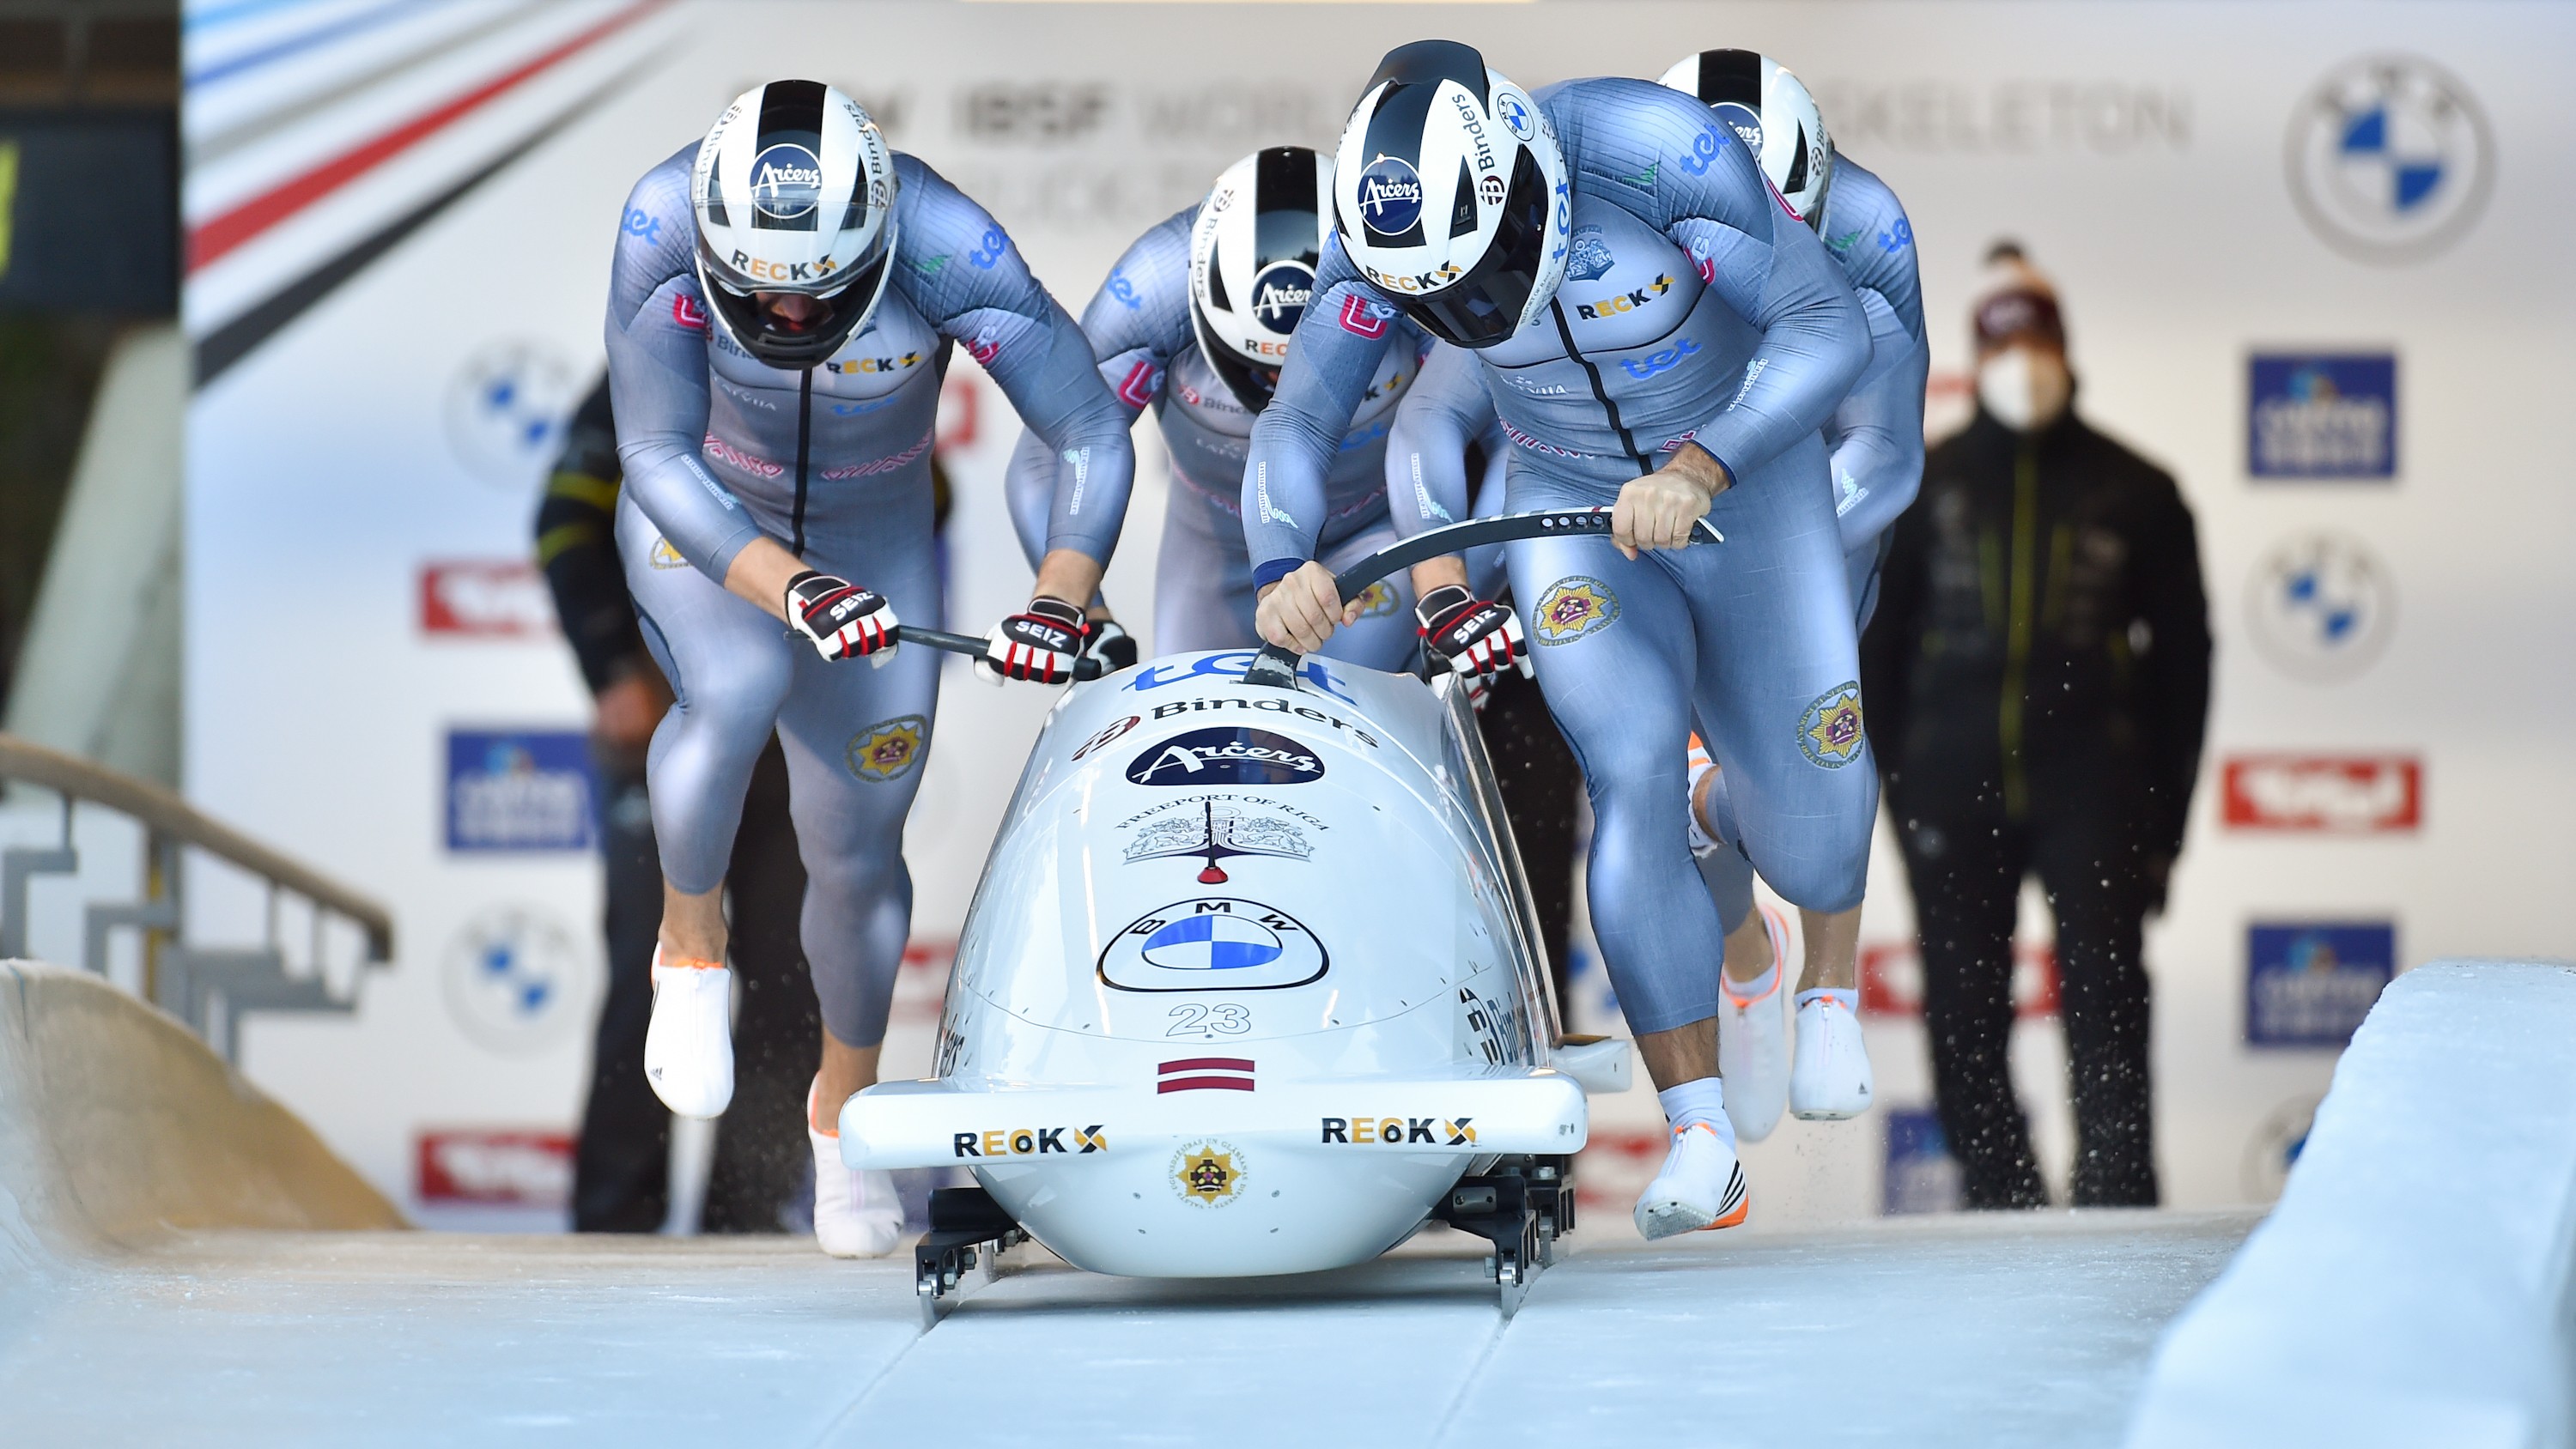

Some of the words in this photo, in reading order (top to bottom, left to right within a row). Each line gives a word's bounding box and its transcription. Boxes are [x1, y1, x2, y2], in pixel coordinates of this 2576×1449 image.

[1452, 94, 1495, 172] Binders
[1680, 123, 1732, 177] tet
[1576, 288, 1651, 320] RECK
[1245, 338, 1289, 357] REC
[1620, 336, 1703, 381] tet
[1014, 620, 1069, 649] SEIZ
[1151, 697, 1379, 749] Binders
[1115, 794, 1238, 830] FREEPORT
[1242, 795, 1277, 806] OF
[1279, 803, 1330, 832] RIGA
[1128, 901, 1300, 936] BMW
[1165, 1003, 1252, 1038] 23
[954, 1127, 1068, 1157] RECK
[1321, 1118, 1437, 1143] RECK
